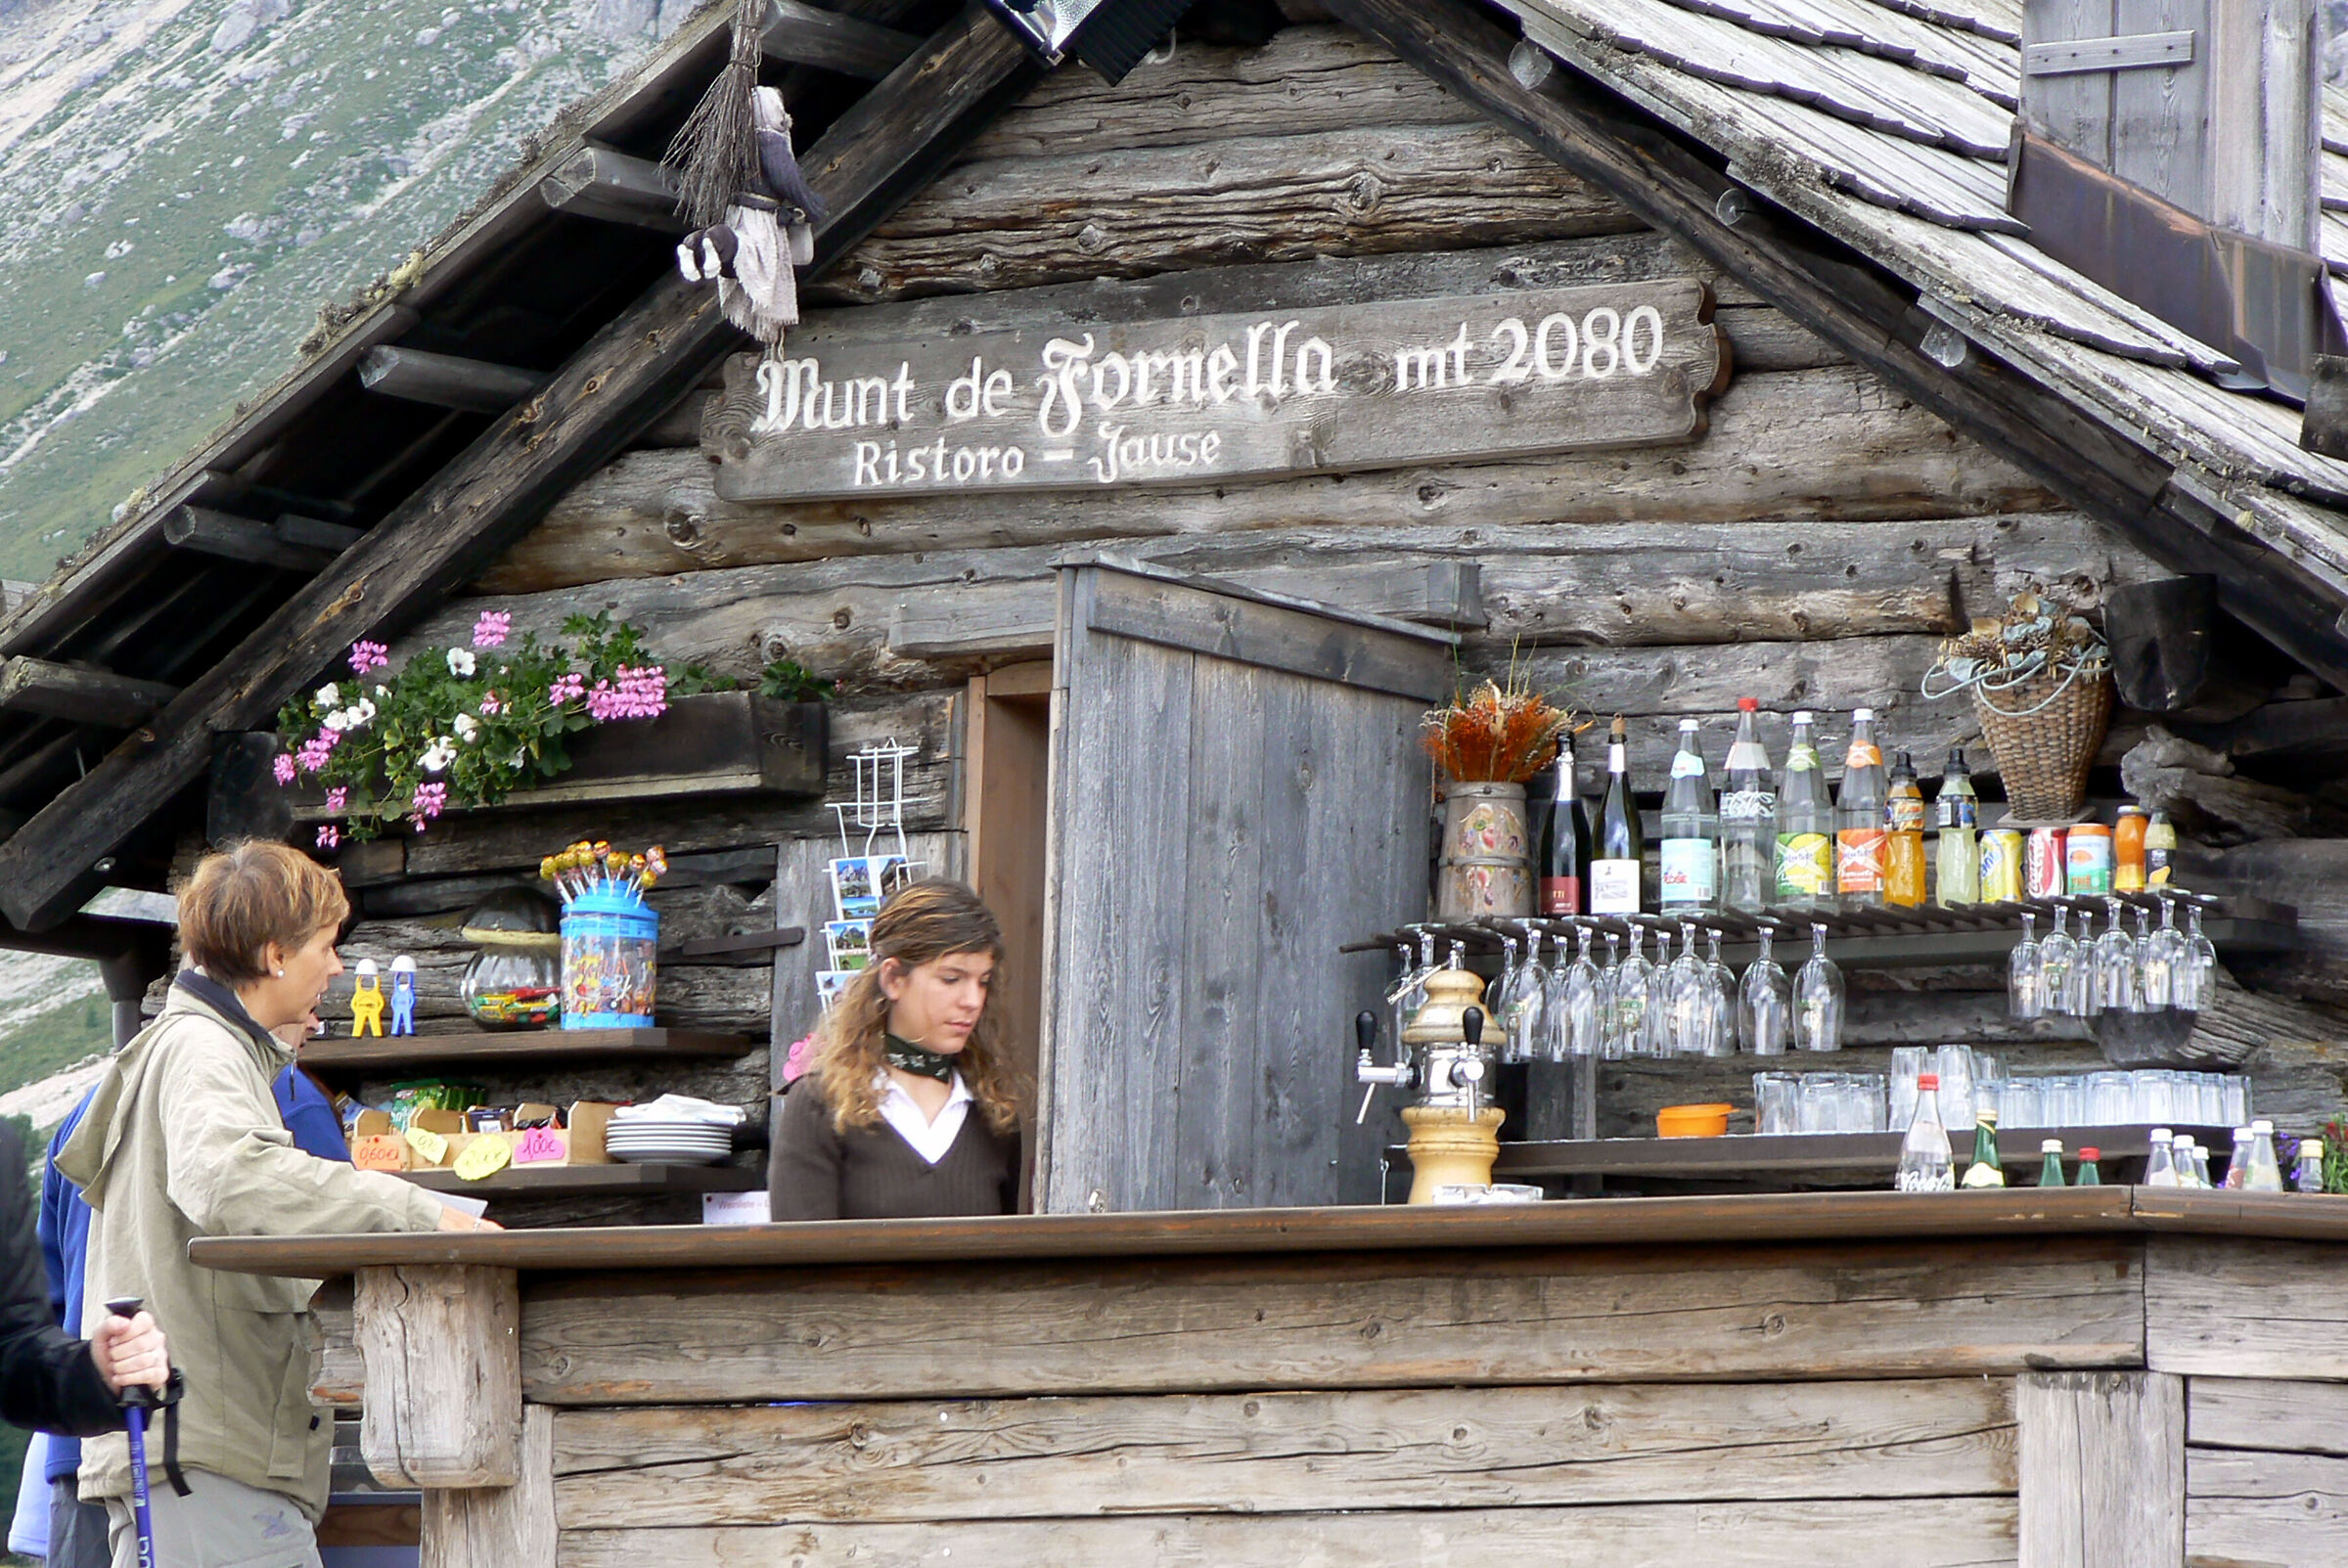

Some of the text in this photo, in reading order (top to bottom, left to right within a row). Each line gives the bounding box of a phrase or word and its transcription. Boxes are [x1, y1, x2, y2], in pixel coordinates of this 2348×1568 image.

[751, 304, 1664, 439] Munt de Fornella mt 2080
[854, 437, 1025, 487] Ristoro
[1087, 421, 1222, 483] Jause
